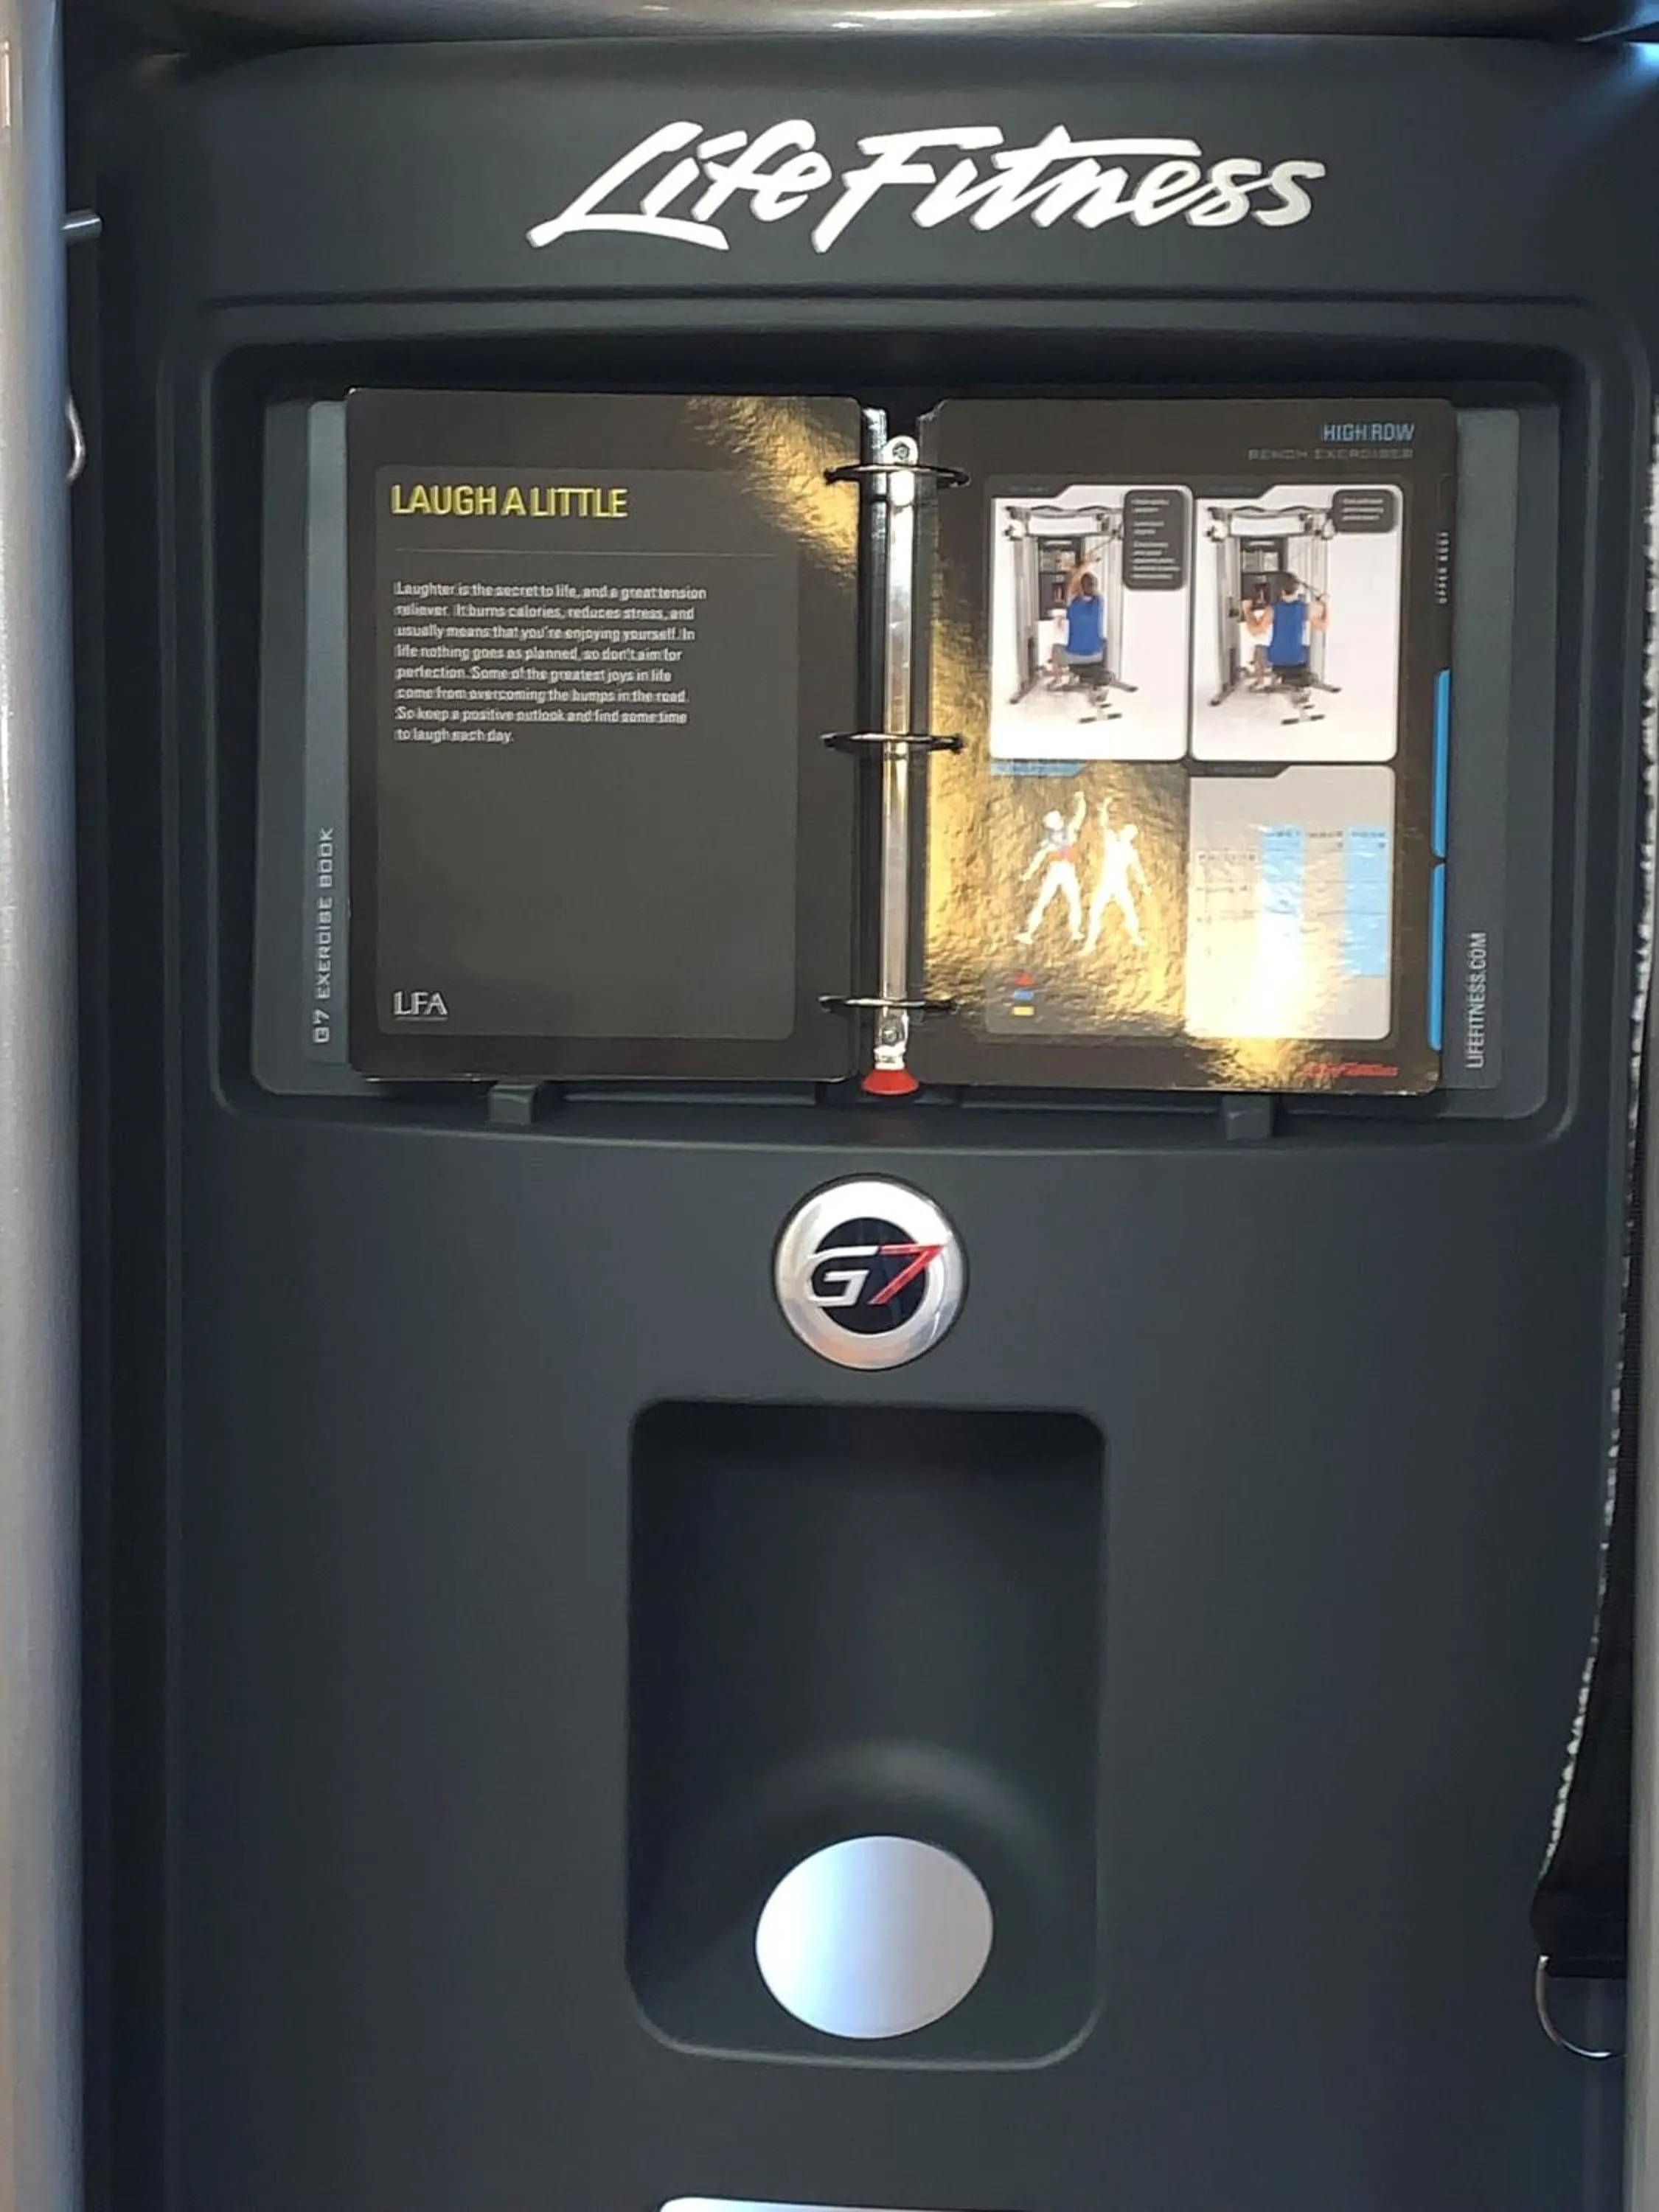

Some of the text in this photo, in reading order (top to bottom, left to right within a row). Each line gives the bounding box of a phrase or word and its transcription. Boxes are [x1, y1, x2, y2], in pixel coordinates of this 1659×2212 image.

[525, 119, 1327, 253] Life Fitness
[1322, 422, 1416, 442] HIGH ROW
[391, 484, 629, 518] LAUGH A LITTLE
[393, 581, 455, 598] Laughter
[457, 582, 470, 597] is
[472, 582, 495, 597] the
[495, 584, 540, 597] secret
[541, 585, 553, 597] to
[582, 585, 608, 598] and
[611, 587, 619, 598] a
[619, 586, 658, 601] great
[658, 585, 707, 599] tension
[453, 603, 467, 616] It
[469, 603, 506, 618] burns
[568, 605, 622, 619] reduces
[670, 607, 695, 620] and
[394, 623, 443, 640] usually
[445, 627, 490, 638] means
[493, 625, 518, 638] that
[519, 625, 563, 641] you're
[566, 626, 620, 642] enjoying
[682, 627, 695, 640] In
[394, 644, 418, 657] life
[420, 645, 470, 661] nothing
[471, 648, 504, 661] goes
[507, 648, 522, 659] as
[583, 649, 600, 660] so
[602, 647, 635, 661] don't
[637, 647, 662, 661] aim
[664, 647, 683, 661] for
[471, 666, 508, 679] Some
[510, 666, 524, 679] of
[526, 667, 548, 680] the
[549, 669, 605, 683] greatest
[605, 669, 635, 684] joys
[636, 669, 649, 681] in
[652, 669, 672, 682] life
[394, 688, 434, 700] come
[436, 686, 467, 700] from
[469, 687, 546, 704] overcoming
[549, 688, 568, 701] the
[571, 688, 616, 703] bumps
[618, 689, 630, 702] in
[632, 689, 653, 702] the
[394, 706, 688, 724] So keep a positive outlook and find some time
[394, 728, 410, 741] to
[413, 727, 450, 744] laugh
[452, 728, 484, 742] each
[318, 827, 334, 888] BOOK
[316, 896, 333, 999] EXERCISE
[393, 991, 448, 1015] LFA
[1465, 931, 1487, 1068] LIFEFITNESS.COM
[805, 1245, 945, 1307] G7
